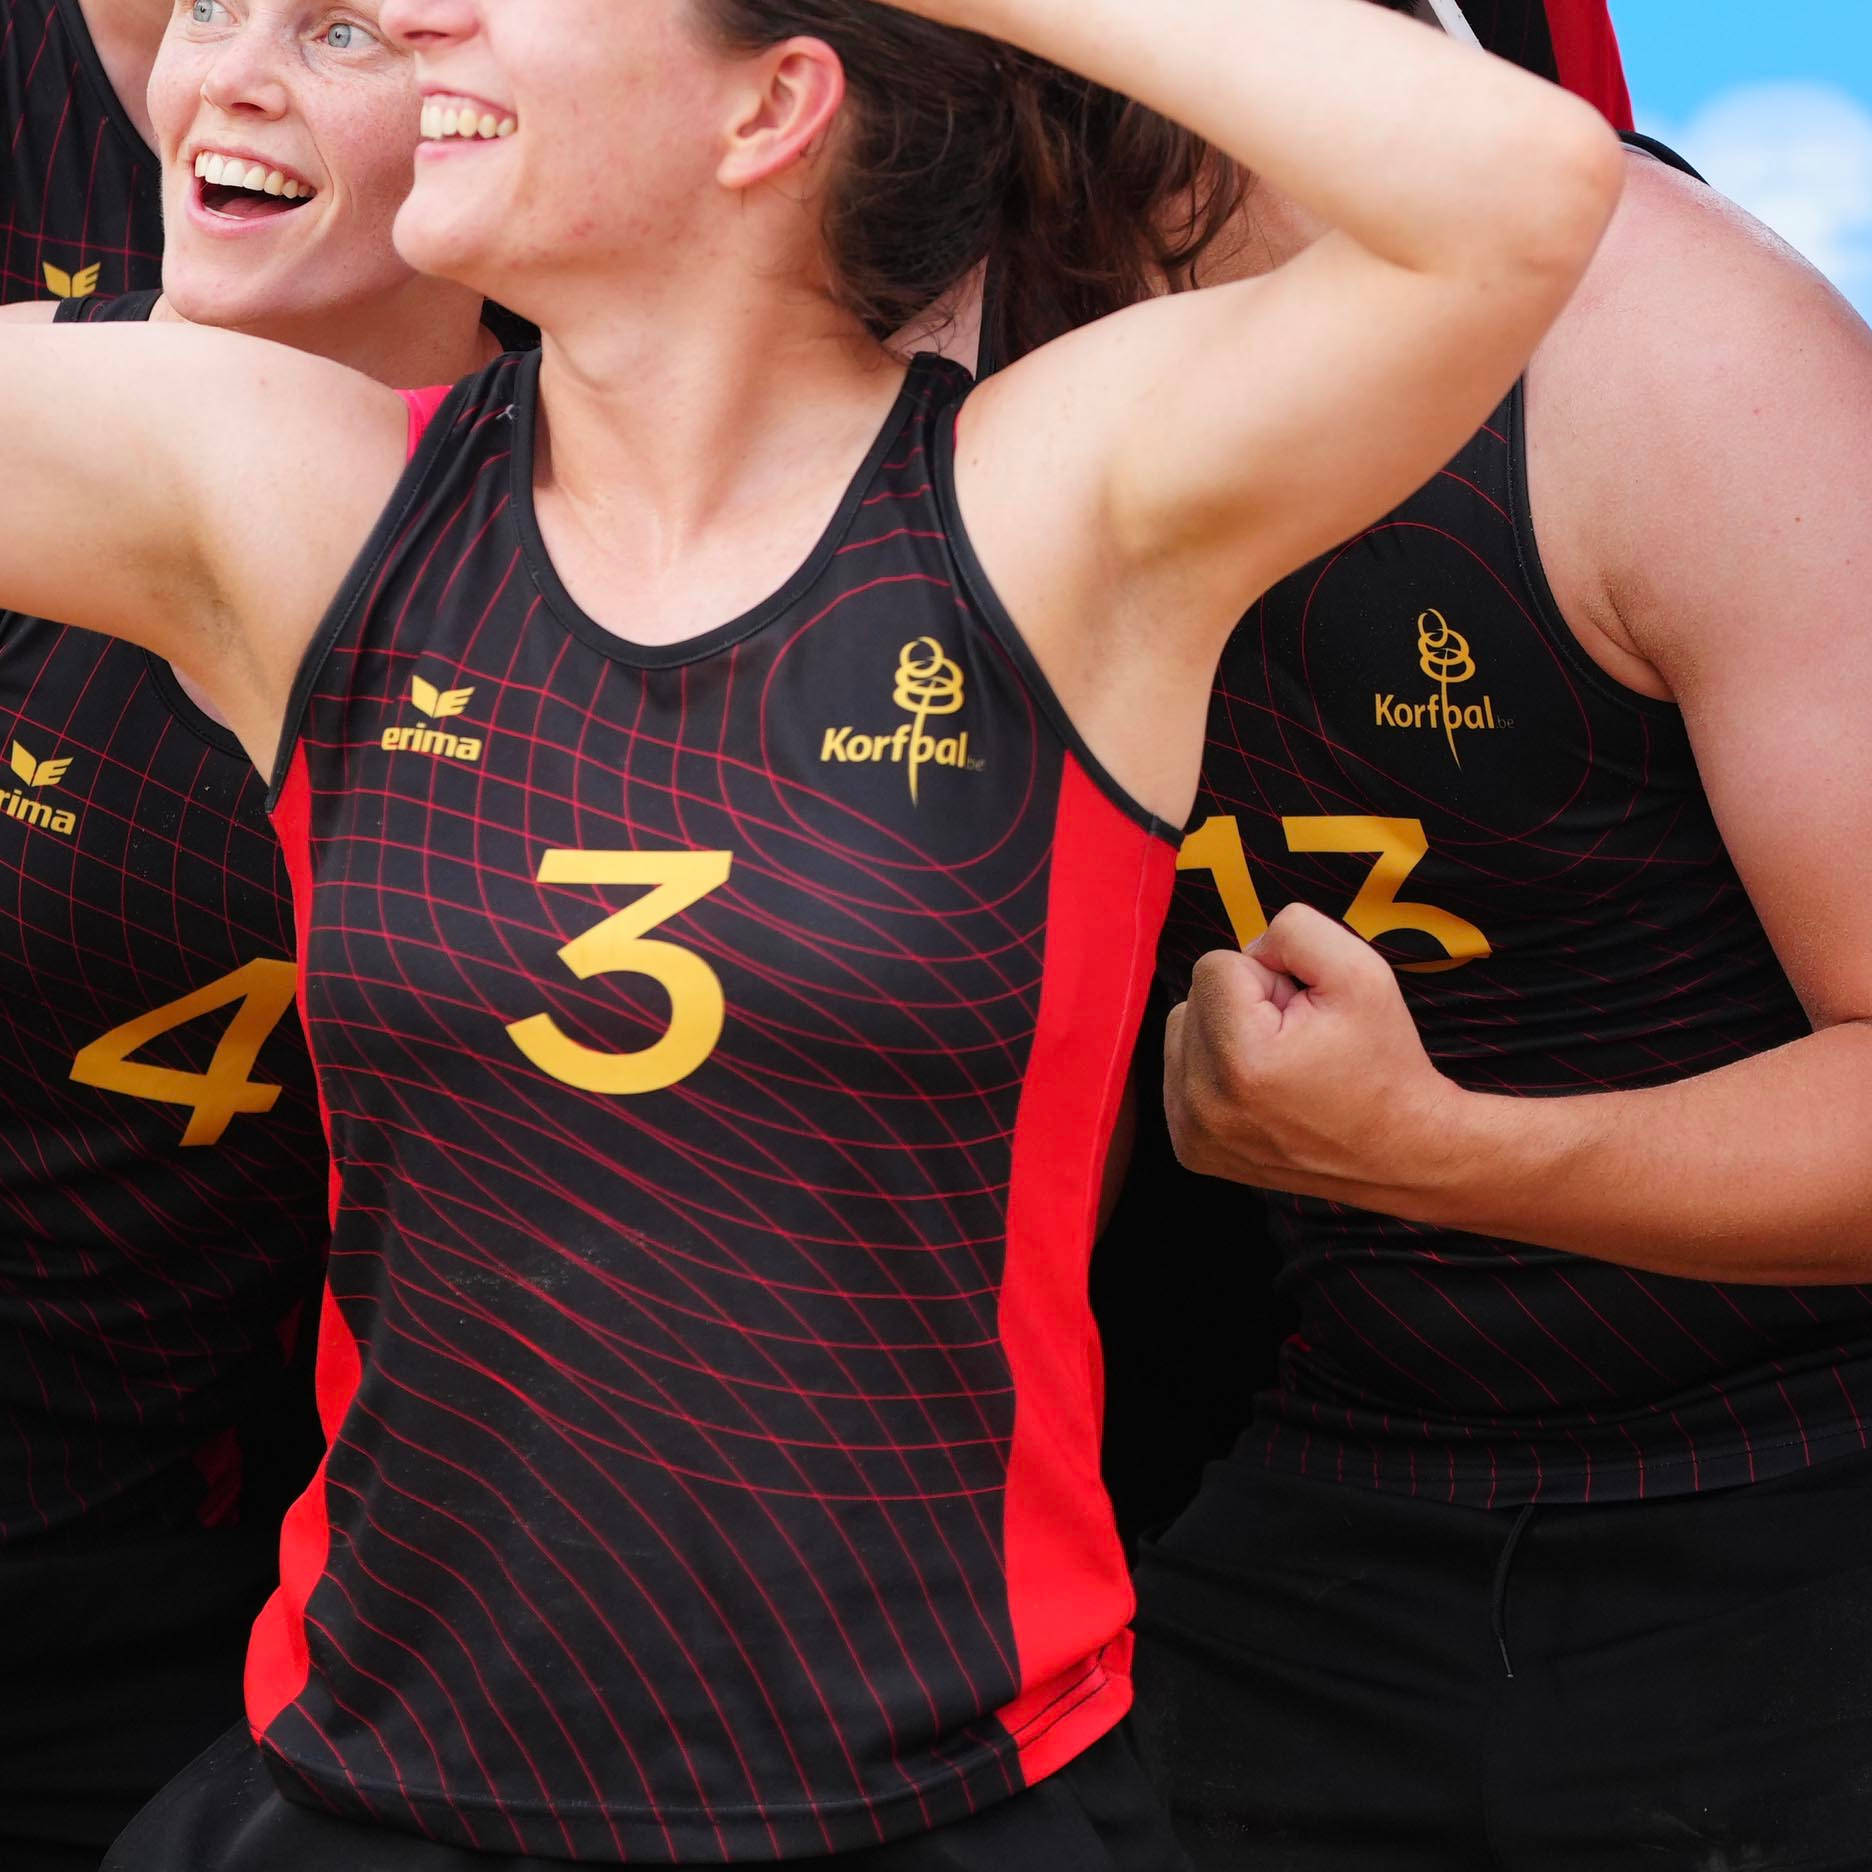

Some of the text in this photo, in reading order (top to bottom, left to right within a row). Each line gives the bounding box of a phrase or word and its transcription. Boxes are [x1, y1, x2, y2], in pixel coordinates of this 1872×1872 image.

[380, 721, 483, 762] erima
[505, 848, 734, 1095] 3
[1175, 814, 1493, 974] 13
[68, 956, 298, 1147] 4
